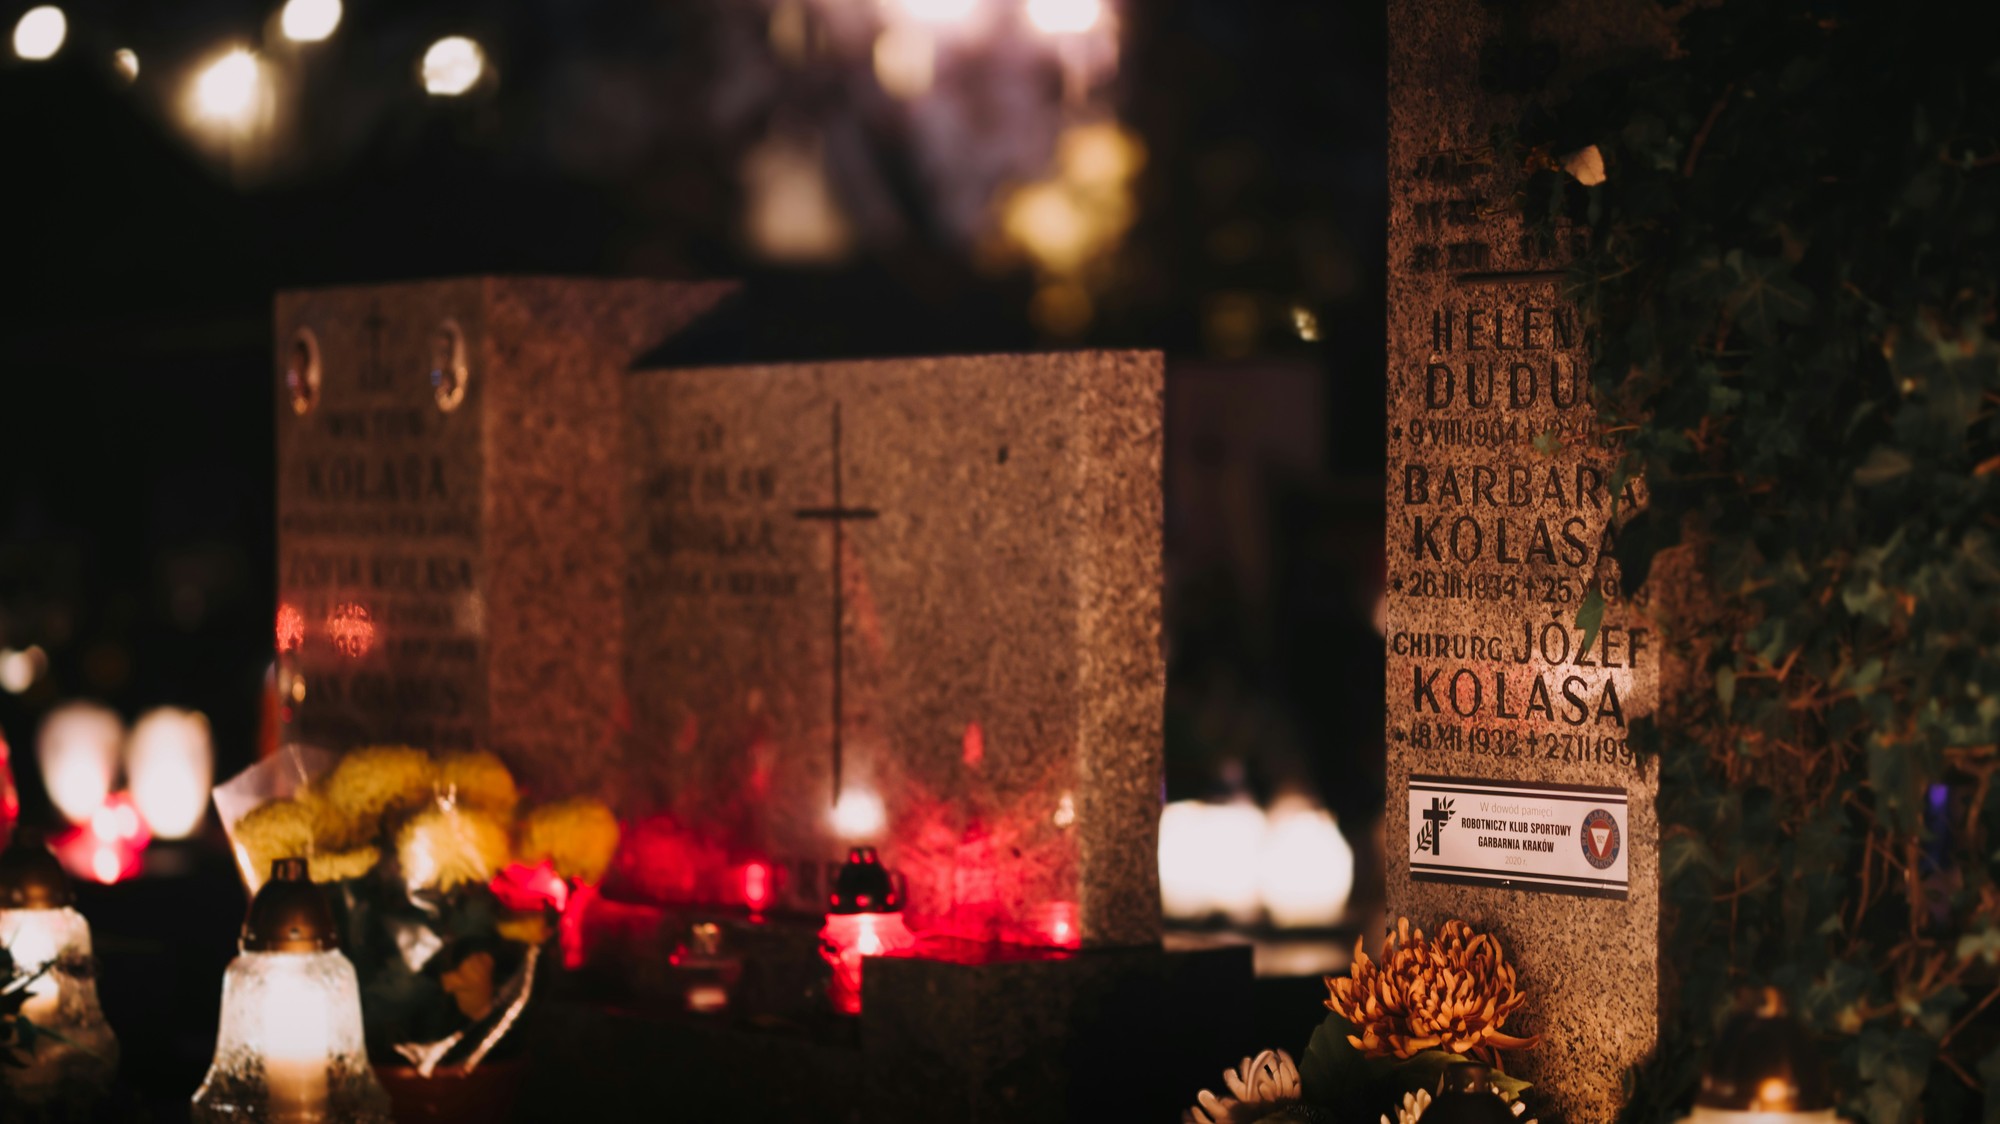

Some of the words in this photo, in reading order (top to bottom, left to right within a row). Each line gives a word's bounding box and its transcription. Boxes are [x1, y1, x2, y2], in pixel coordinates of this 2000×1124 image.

[1432, 306, 1592, 351] HELEN
[1426, 361, 1592, 410] DUDU
[1409, 571, 1437, 598] 26
[1393, 631, 1503, 662] CHIRURG
[1513, 609, 1648, 669] JÓZEF
[1413, 666, 1626, 727] KOLASA
[1468, 726, 1522, 759] 1932
[1594, 734, 1636, 767] 199
[1480, 801, 1490, 812] W
[1491, 802, 1520, 815] dowód
[1521, 805, 1553, 818] pamięci
[1461, 817, 1507, 832] ROBOTNICZY
[1509, 820, 1529, 834] KLUB
[1530, 822, 1572, 837] SPORTOWY
[1478, 835, 1521, 851] GARBARNIA
[1522, 838, 1555, 853] KRAKÓW
[1504, 855, 1522, 866] 2020
